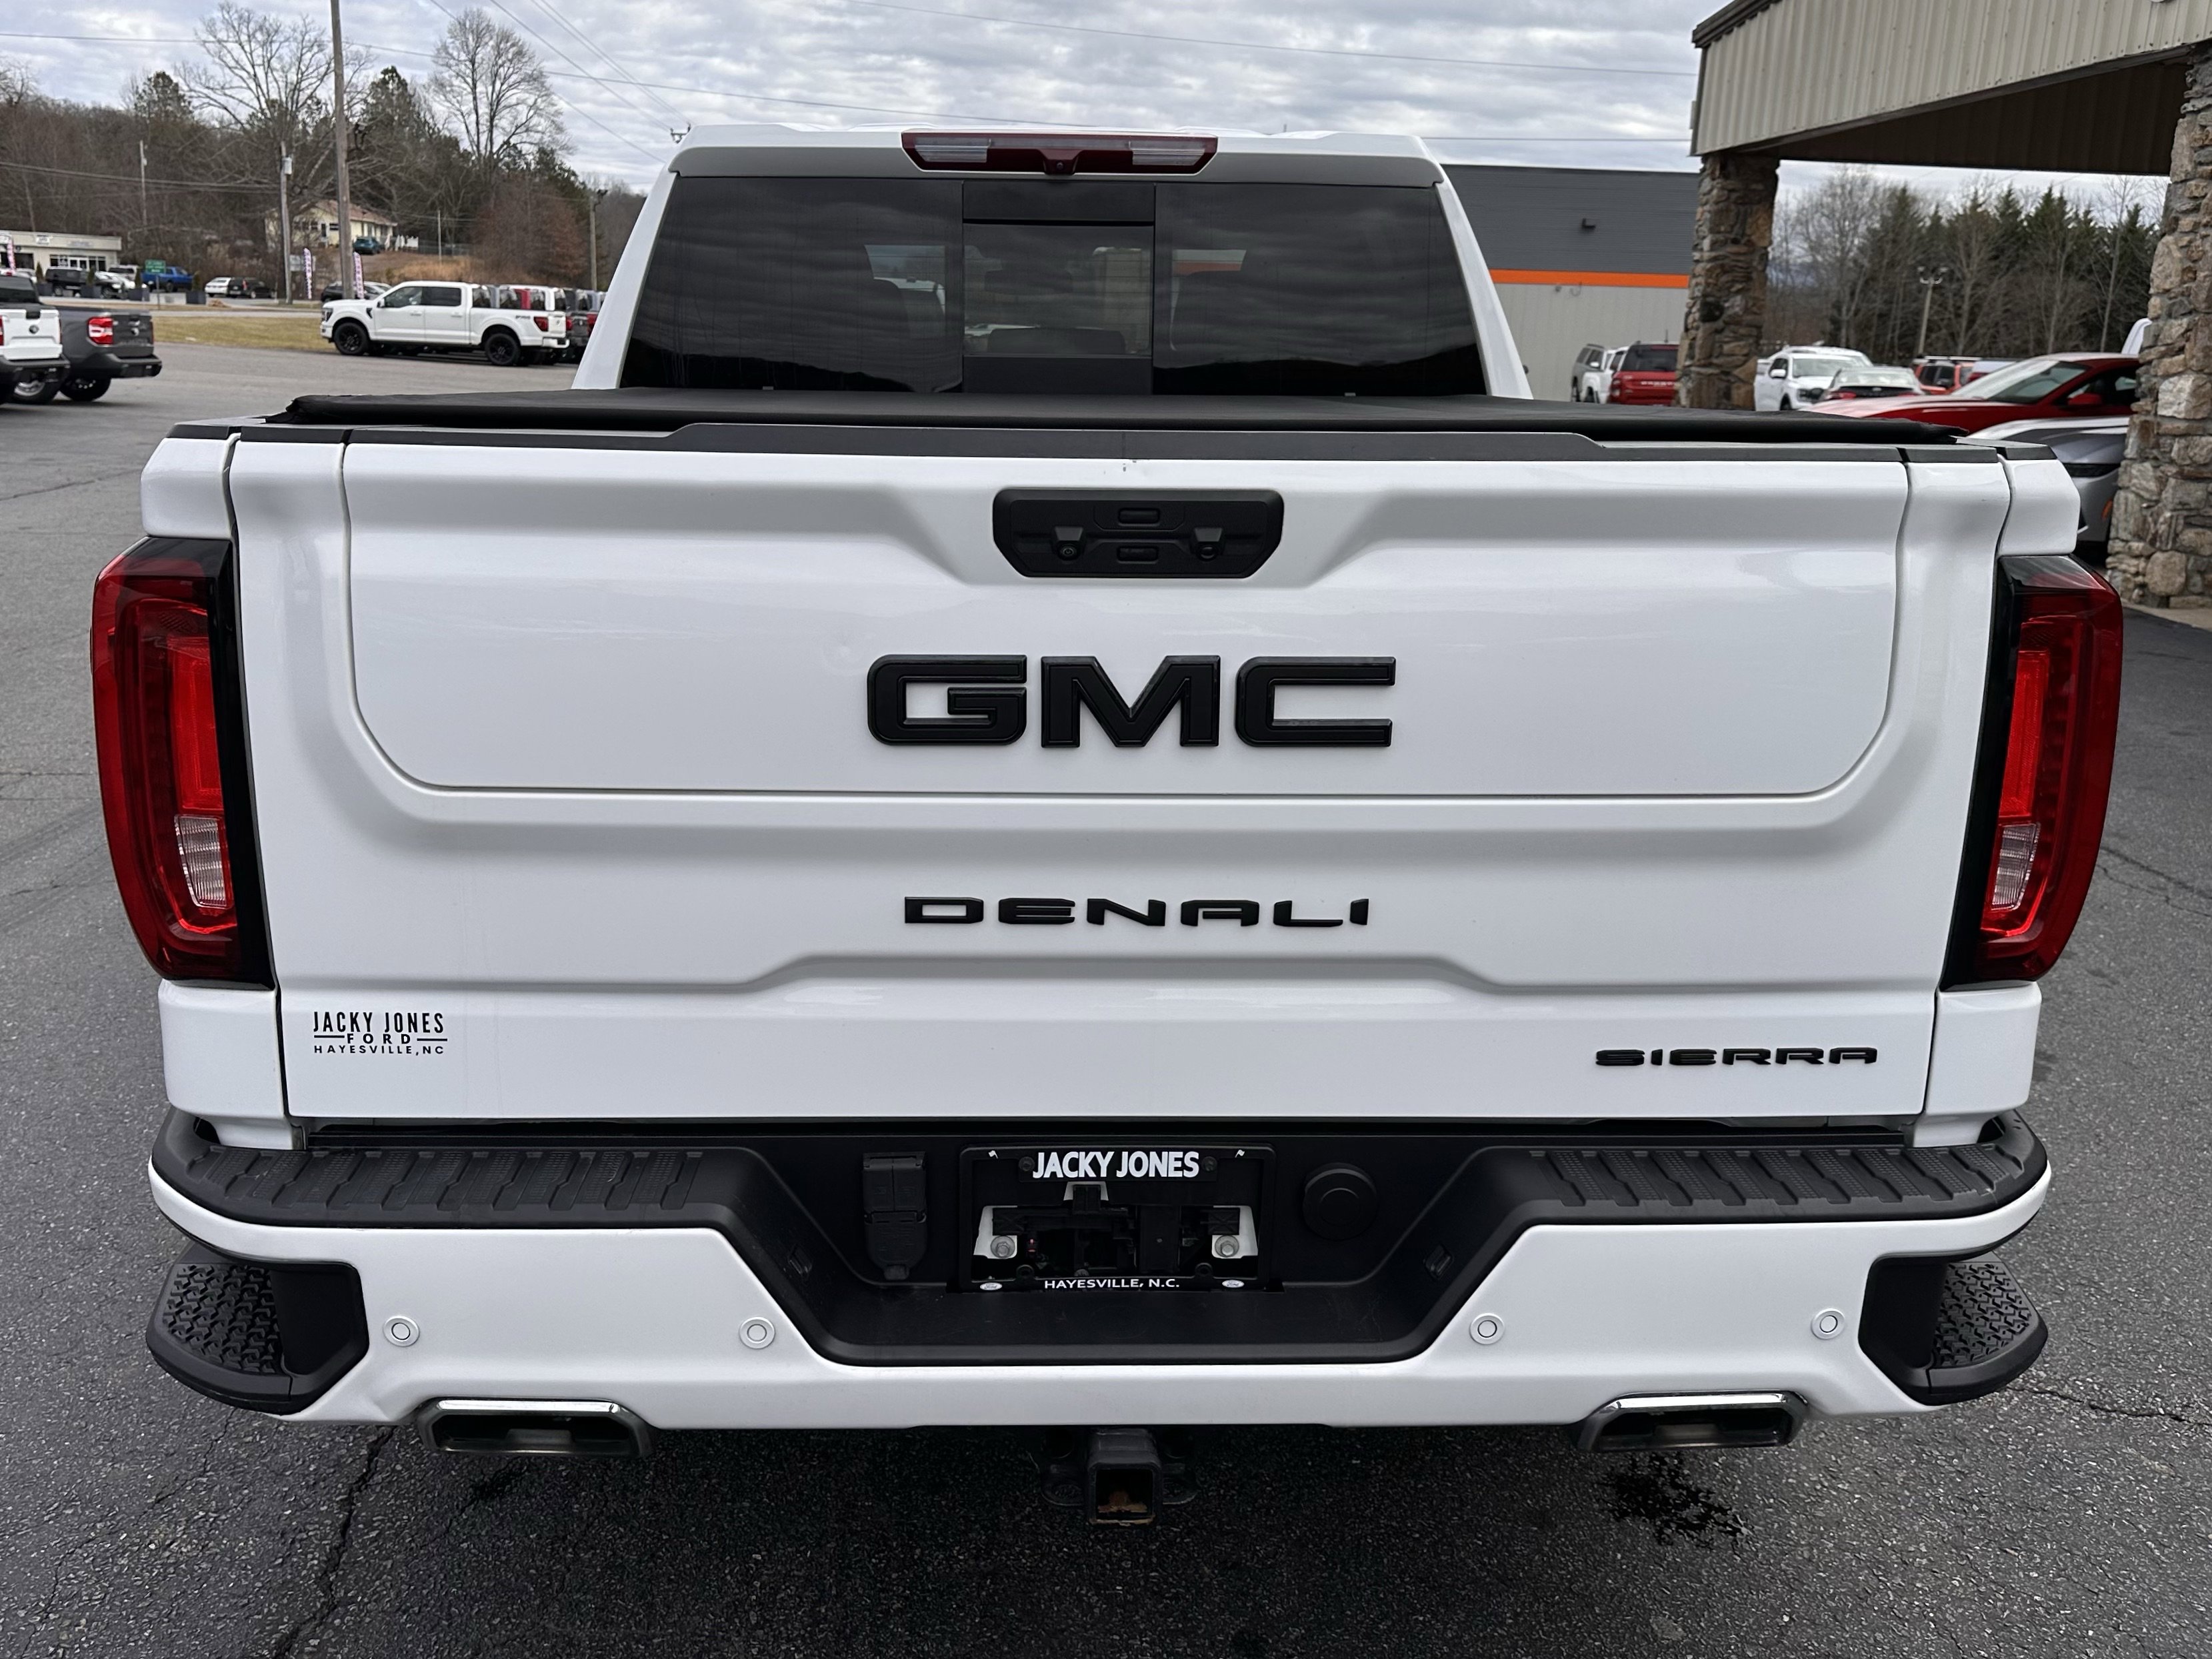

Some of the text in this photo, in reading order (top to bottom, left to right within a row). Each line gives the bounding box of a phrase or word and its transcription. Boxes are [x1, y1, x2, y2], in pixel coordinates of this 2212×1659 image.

[867, 654, 1396, 748] GMC
[905, 896, 1369, 928] DENALI
[313, 1012, 443, 1034] JACKY JONES
[347, 1034, 411, 1044] FORD
[1596, 1047, 1877, 1066] SIERRA
[1033, 1151, 1199, 1178] JACKY JONES
[1044, 1278, 1179, 1289] HAYESVILLE, N.C.
